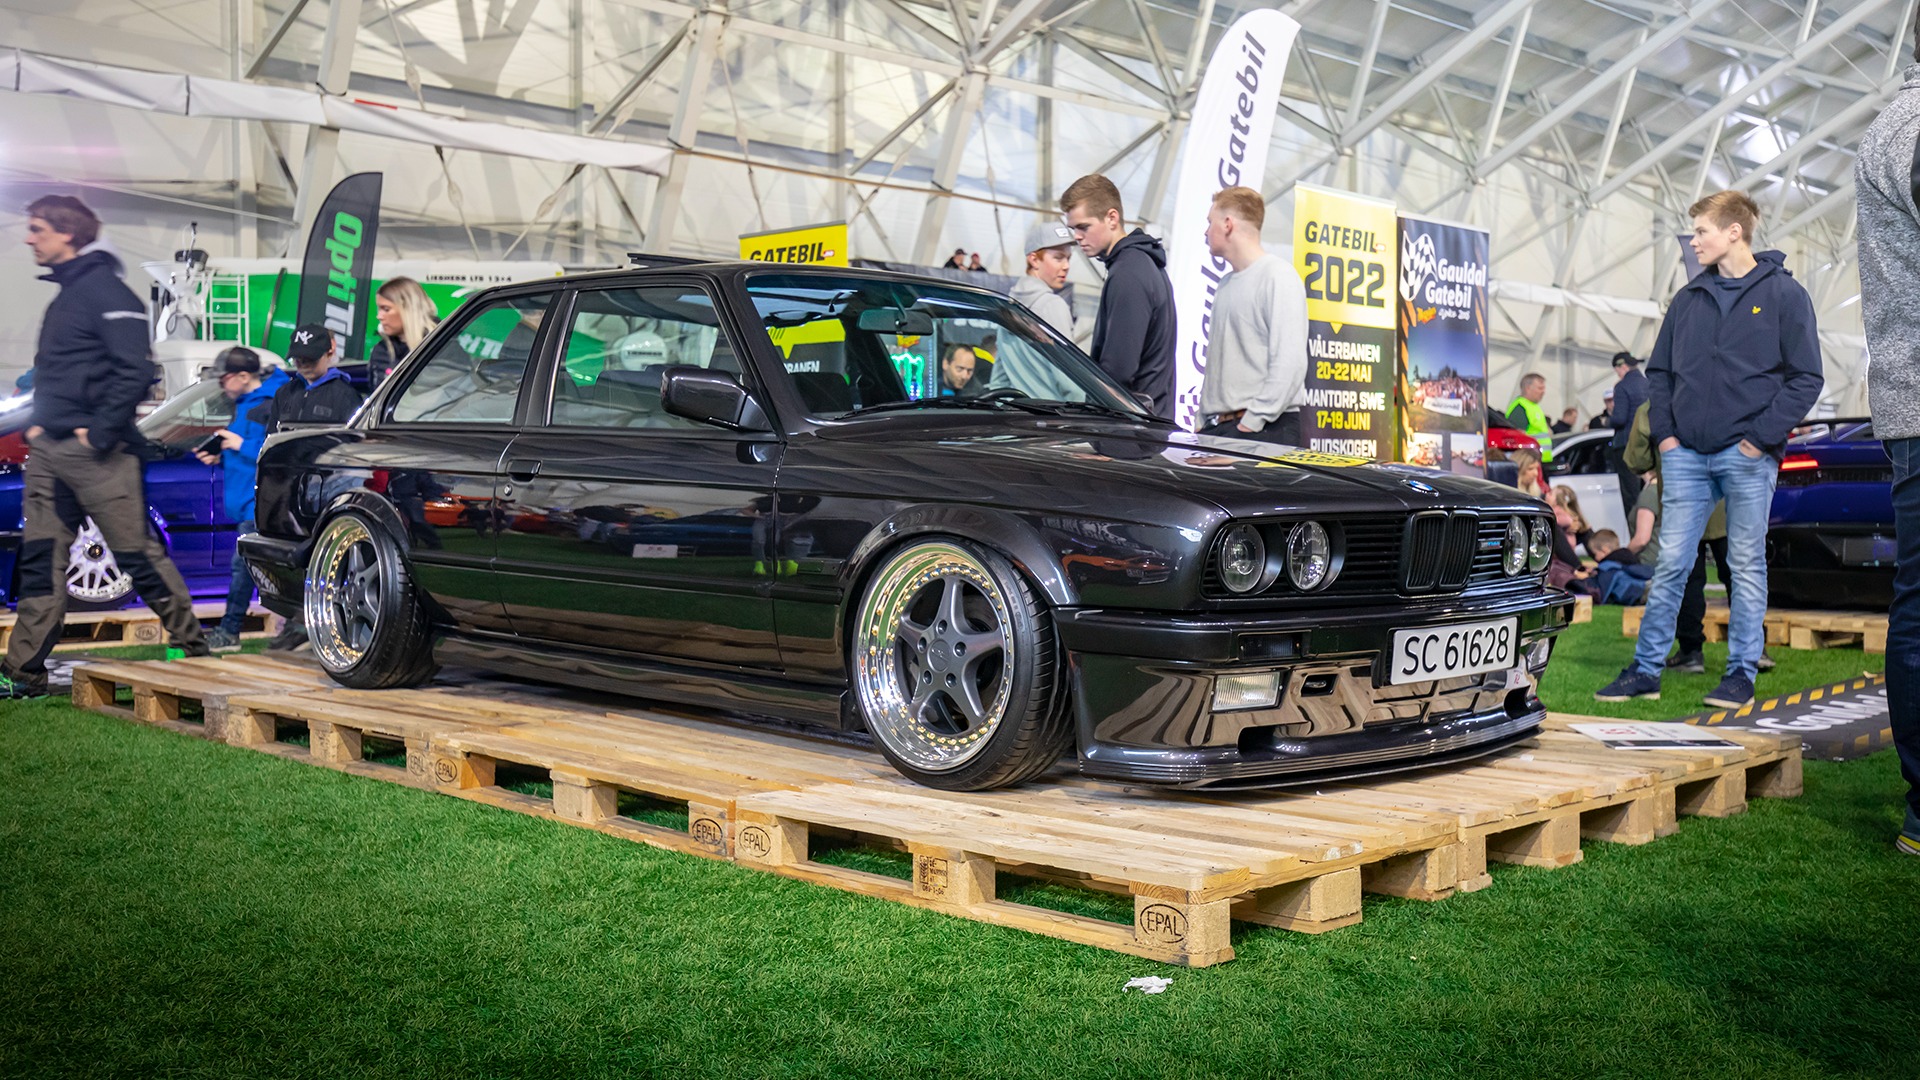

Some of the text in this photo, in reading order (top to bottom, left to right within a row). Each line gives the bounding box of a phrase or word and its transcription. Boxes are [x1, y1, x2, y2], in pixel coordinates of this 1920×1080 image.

[1218, 31, 1266, 190] Gatebil
[1305, 221, 1377, 253] GATEBIL
[750, 242, 825, 263] GATEBIL
[1305, 252, 1384, 308] 2022
[1437, 258, 1486, 287] Gauldal
[1425, 280, 1472, 309] Gatebil
[1308, 334, 1381, 363] VÅLERBANEN
[1316, 361, 1373, 383] 20-22 MAI
[1316, 410, 1371, 431] 17-19 JUNI
[1402, 625, 1509, 676] SC 61628
[695, 823, 718, 842] EPAL
[743, 831, 767, 852] EPAL
[1147, 910, 1182, 937] EPAL
